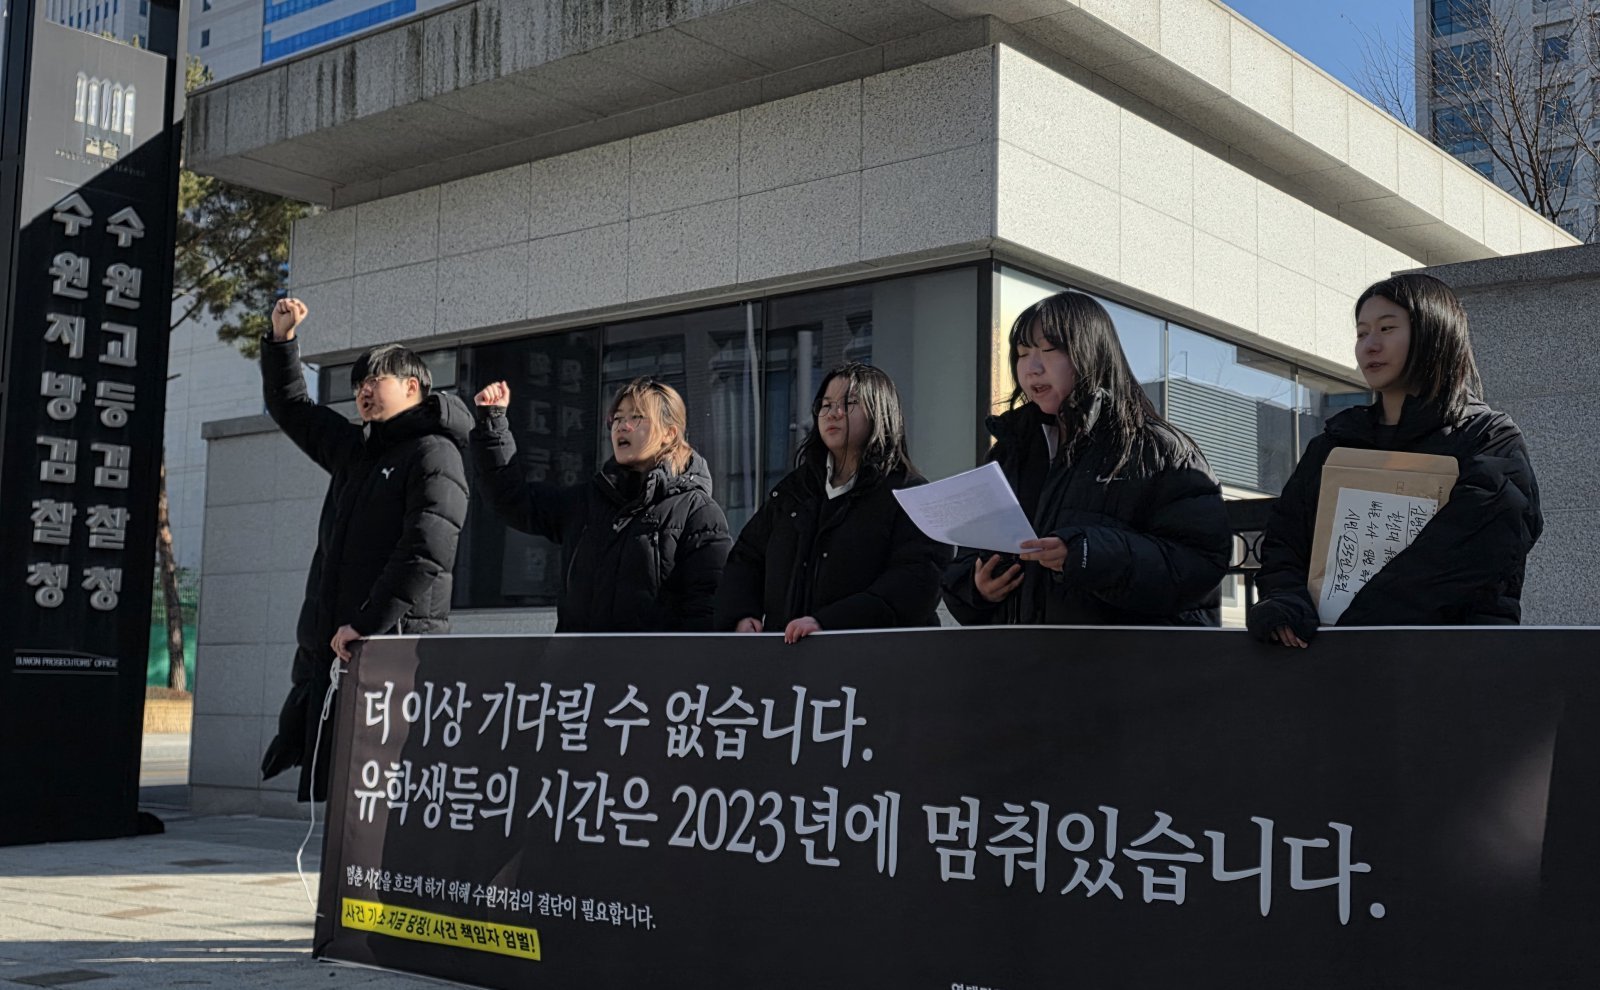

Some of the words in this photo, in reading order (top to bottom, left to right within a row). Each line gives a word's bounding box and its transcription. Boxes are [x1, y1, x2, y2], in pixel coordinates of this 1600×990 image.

[26, 193, 94, 608] 수원지방검찰청
[82, 206, 146, 611] 수원고등검찰청
[1344, 508, 1361, 530] 시민
[364, 687, 391, 744] 더
[402, 682, 471, 748] 이상
[478, 682, 591, 752] 기다릴
[603, 685, 650, 756] 수
[665, 685, 873, 768] 없습니다.
[354, 760, 519, 837] 유학생들의
[528, 769, 658, 848] 시간은
[668, 785, 900, 878] 2023년에
[921, 795, 1386, 926] 멈춰있습니다.
[345, 904, 365, 922] 사건
[367, 907, 386, 926] 기소
[388, 911, 407, 931] 지금
[405, 914, 431, 936] 당장!
[433, 919, 458, 940] 사건
[461, 923, 500, 947] 책임자
[502, 930, 535, 953] 엄벌!
[346, 864, 363, 887] 멈춘
[364, 867, 392, 892] 시간을
[393, 873, 423, 897] 흐르게
[424, 877, 446, 901] 하기
[447, 881, 471, 904] 위해
[472, 883, 533, 914] 수원지검의
[537, 893, 576, 920] 결단이
[580, 899, 656, 930] 필요합니다.
